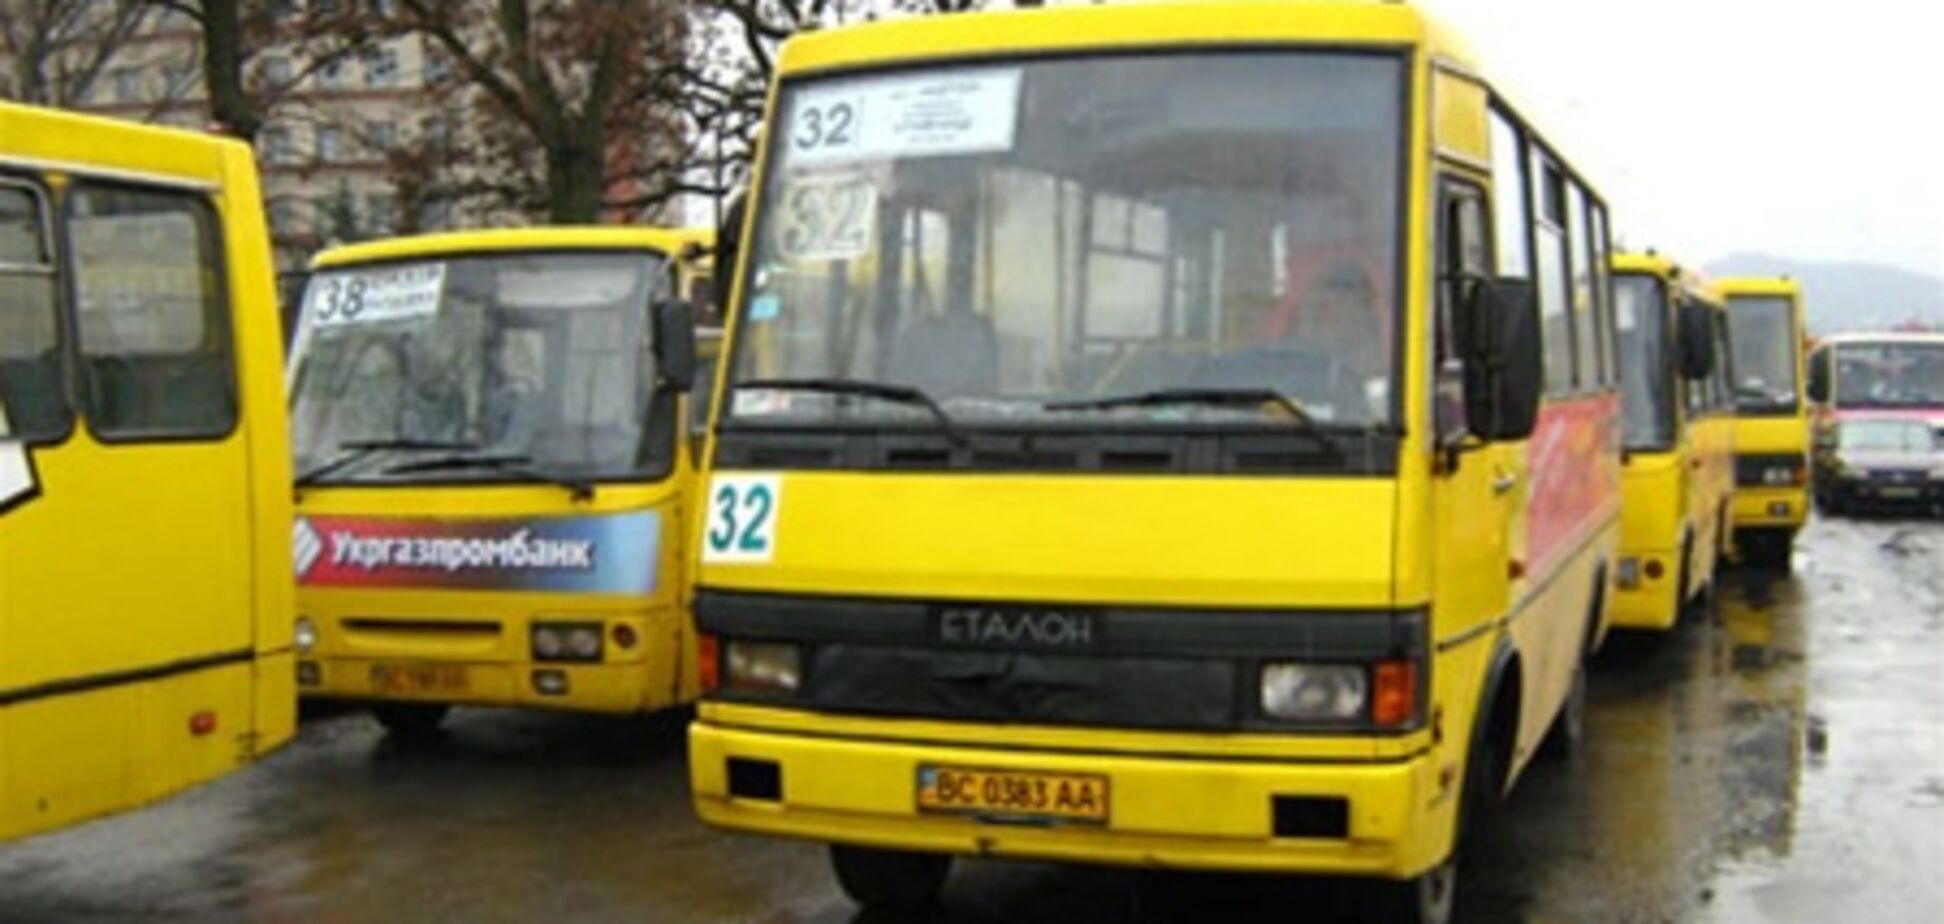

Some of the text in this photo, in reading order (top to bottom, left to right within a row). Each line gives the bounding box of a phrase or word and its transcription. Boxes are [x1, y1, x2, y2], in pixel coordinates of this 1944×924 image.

[796, 101, 853, 149] 32
[783, 180, 868, 257] 32
[318, 278, 368, 321] 38
[710, 484, 772, 552] 32
[331, 527, 594, 571] Укргазпромбанк
[940, 610, 1092, 645] ЕТАЛОН
[937, 772, 1097, 812] BC 0383 AA
